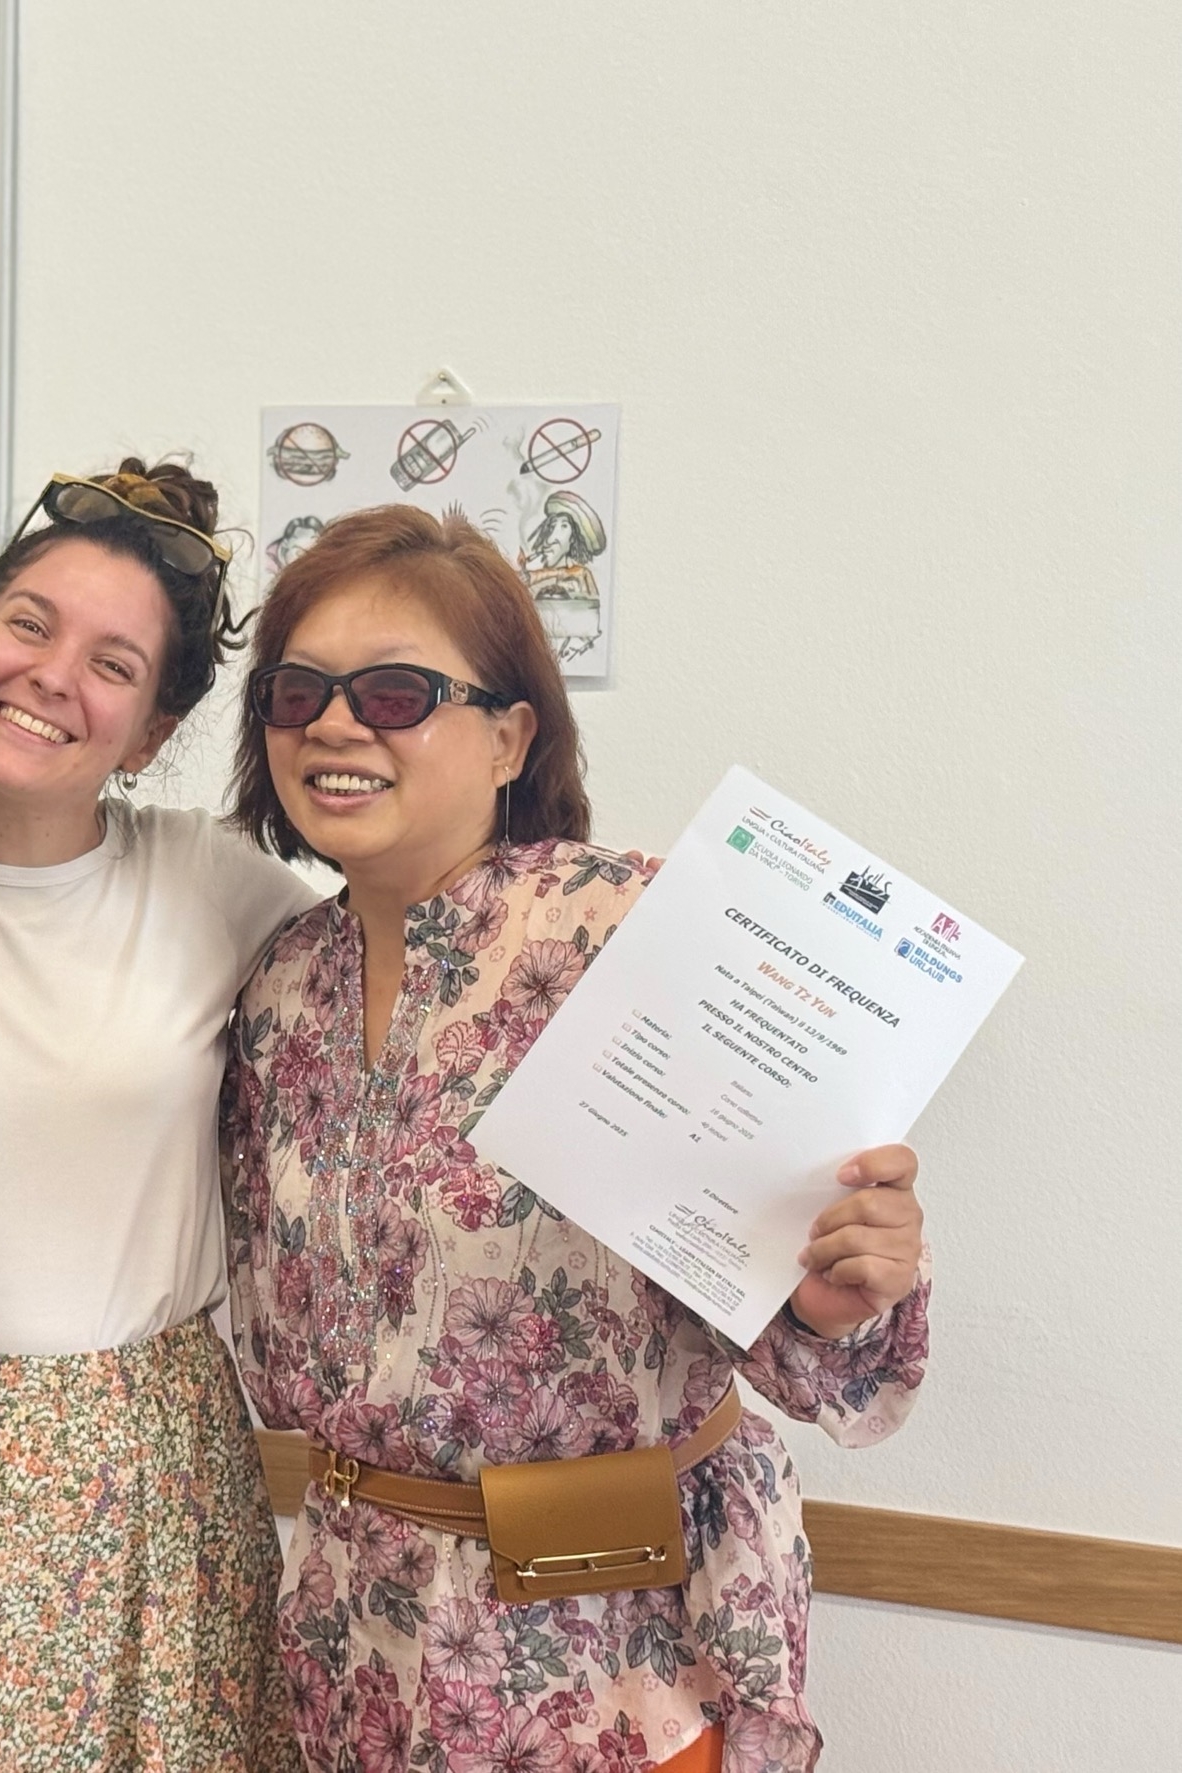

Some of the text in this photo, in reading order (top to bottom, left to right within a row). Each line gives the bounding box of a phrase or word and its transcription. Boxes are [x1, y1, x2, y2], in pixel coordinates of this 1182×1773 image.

[741, 815, 765, 835] LINGUA
[769, 834, 797, 856] CULTURA
[796, 852, 825, 874] ITALIANA
[751, 840, 813, 884] SCUOLA LEONARDO
[747, 846, 759, 858] DA
[783, 870, 810, 891] TORINO
[832, 900, 883, 938] EDUITALIA
[724, 907, 809, 966] CERTIFICATO
[806, 963, 827, 978] DI
[824, 974, 900, 1028] FREQUENZA
[908, 954, 945, 983] URLAUB
[913, 946, 962, 983] BILDUNGS
[640, 1015, 671, 1040] Materia:
[714, 964, 734, 980] Nata
[740, 981, 765, 1000] Taipei
[761, 997, 799, 1024] (Taiwan)
[796, 1020, 806, 1028] il
[803, 1025, 847, 1055] 13/9/1969
[729, 998, 808, 1054] HA FREQUENTATO
[619, 1042, 643, 1060] Inizio
[642, 1059, 666, 1076] corso:
[630, 1029, 648, 1043] Tipo
[646, 1041, 670, 1060] corso:
[697, 999, 818, 1082] PRESSO IL NOSTRO CENTRO
[701, 1022, 791, 1088] IL SEGUENTE CORSO:
[601, 1069, 701, 1143] Valutazione finale: A1
[611, 1056, 635, 1075] Totale
[666, 1097, 690, 1115] corso:
[587, 1107, 610, 1125] Giugno
[708, 1192, 738, 1214] Direttore
